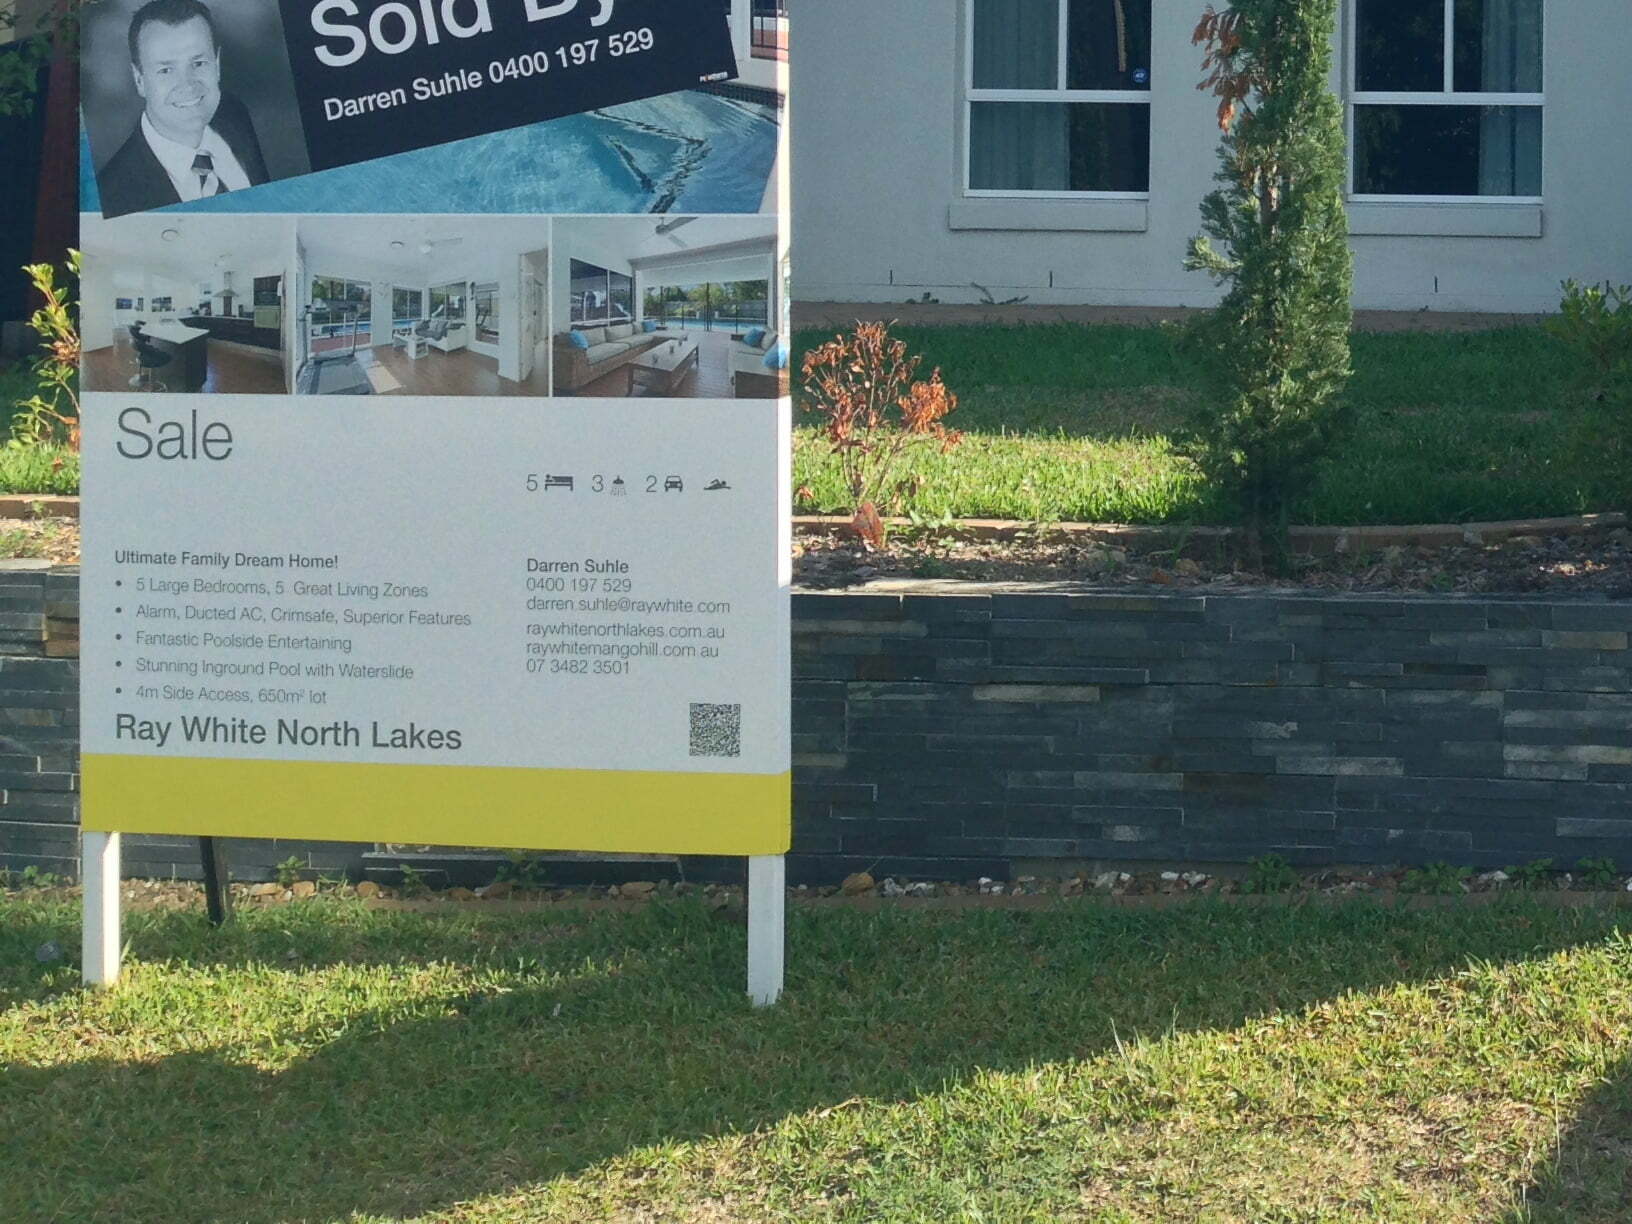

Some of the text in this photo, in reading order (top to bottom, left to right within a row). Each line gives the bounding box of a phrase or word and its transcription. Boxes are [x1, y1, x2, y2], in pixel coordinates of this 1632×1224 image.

[323, 27, 655, 121] Darren Suhle 0400 197 529
[115, 406, 234, 461] Sale
[526, 473, 658, 493] 5 3 2
[114, 550, 339, 570] Ultimate Family Dream Home!
[526, 558, 630, 574] Darren Suhle
[136, 577, 429, 600] 5 Large Bedrooms, 5 Great Living Zones
[526, 577, 632, 593] 0400 197 529
[526, 595, 731, 614] darren.suhle@raywhite.com
[136, 604, 472, 627] Alarm, Ducted AC, Crimsafe, Superior Features
[526, 622, 725, 640] raywhitenorthlakes.com.au
[136, 630, 352, 653] Fantastic Poolside Entertaining
[526, 641, 719, 660] raywhitemangohill.com.au
[136, 657, 414, 679] Stunning Inground Pool with Waterslide
[526, 658, 630, 674] 07 3482 3501
[136, 685, 159, 699] 4m
[162, 684, 195, 701] Side
[198, 687, 254, 704] Access,
[309, 689, 327, 705] lot
[115, 713, 462, 750] Ray White North Lakes
